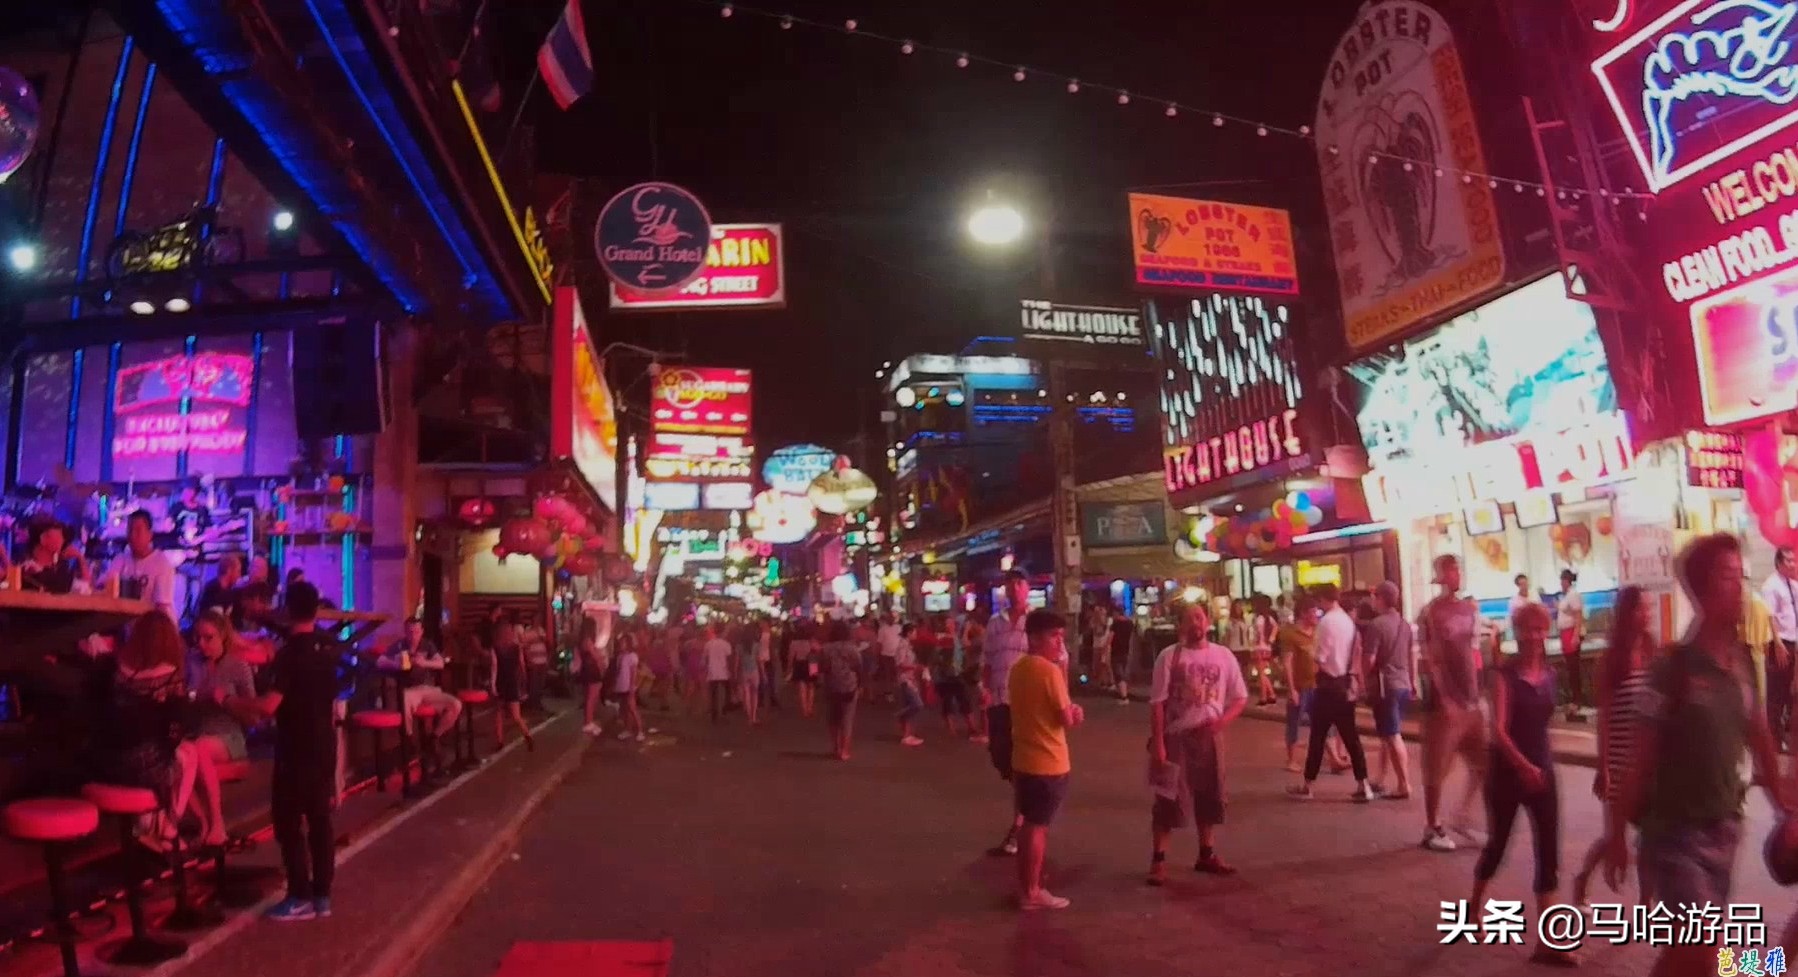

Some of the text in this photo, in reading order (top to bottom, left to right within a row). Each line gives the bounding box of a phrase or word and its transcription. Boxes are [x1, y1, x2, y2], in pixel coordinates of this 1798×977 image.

[1353, 49, 1393, 97] POT
[1175, 204, 1261, 243] LOBSTER
[1205, 227, 1235, 242] POT
[604, 245, 702, 261] Grand Hotel
[705, 237, 770, 267] ARIN
[1021, 308, 1141, 336] LIGHTHOUSE
[1164, 409, 1301, 492] LIGHTHOUSE
